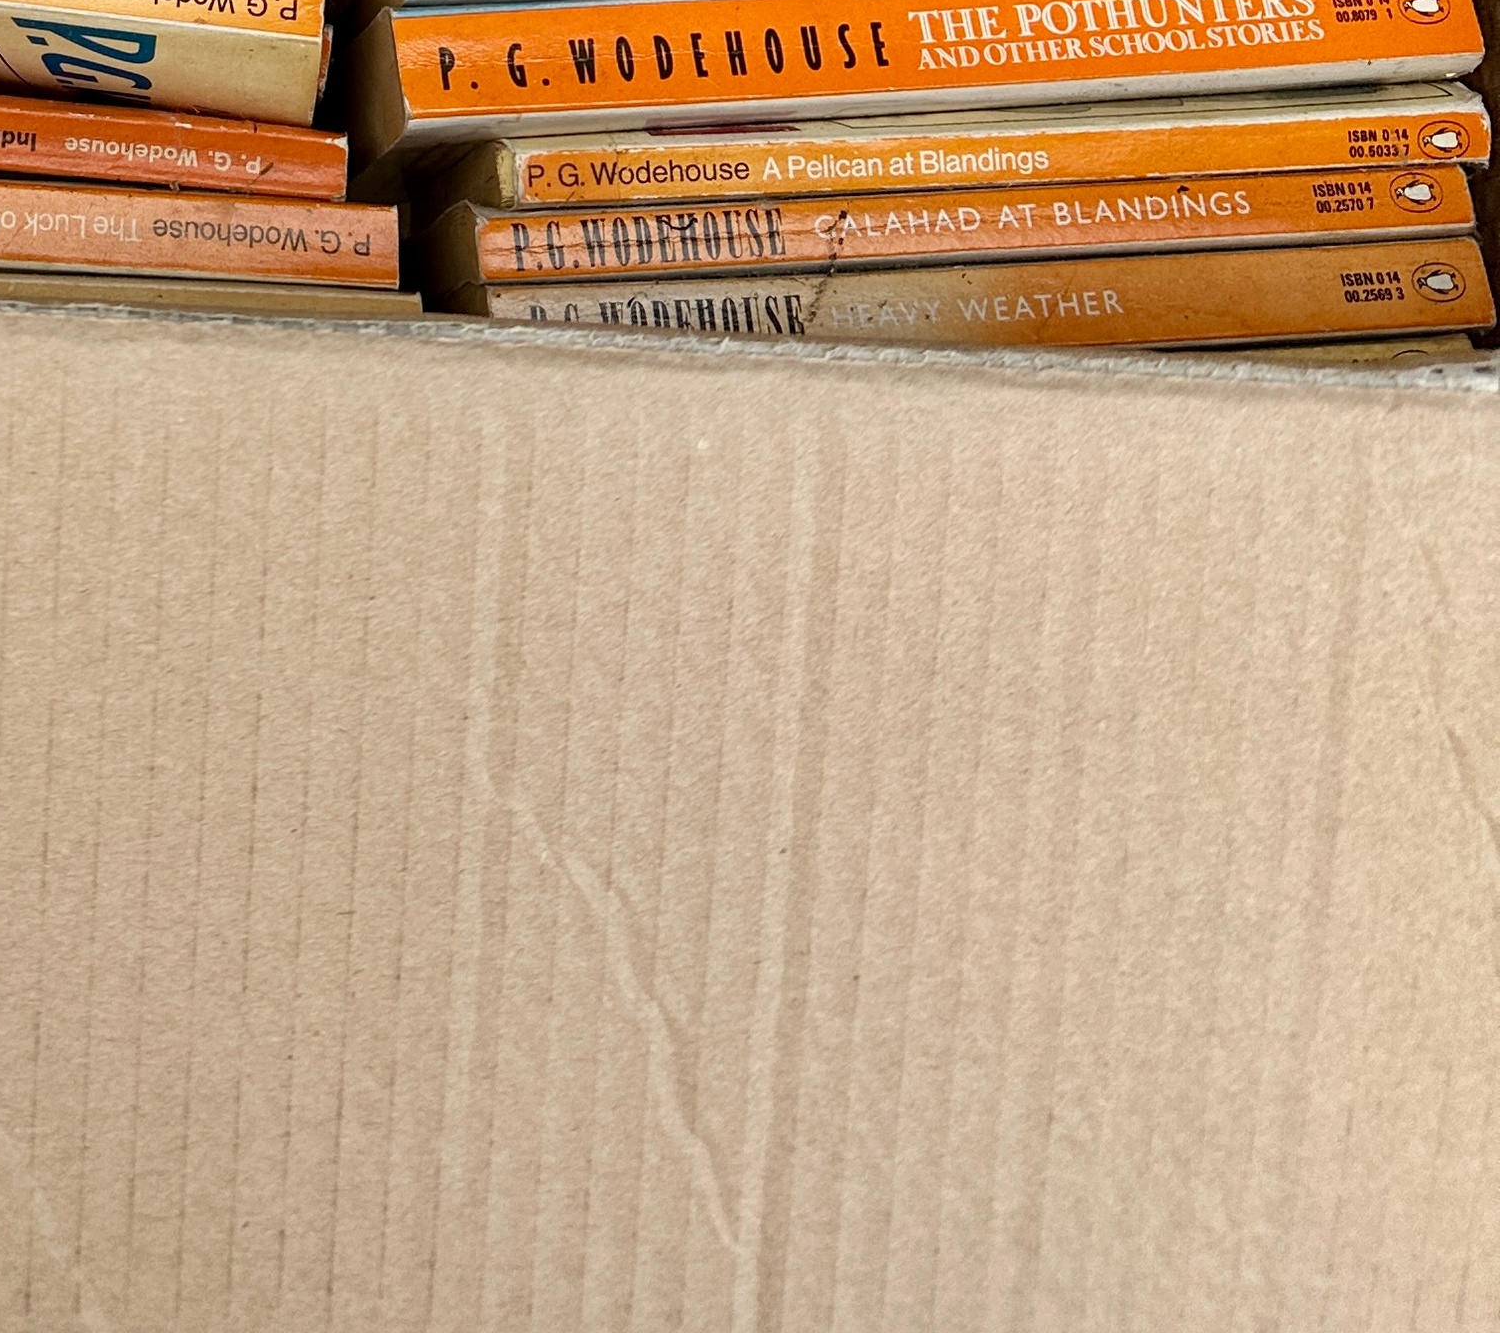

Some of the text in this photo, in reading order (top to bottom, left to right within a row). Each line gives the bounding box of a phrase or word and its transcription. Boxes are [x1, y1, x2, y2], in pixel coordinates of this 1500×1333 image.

[568, 21, 890, 84] WODEHOUSE
[907, 7, 1007, 46] THE
[918, 18, 1325, 71] AND OTHER SCHOOL STORIES
[64, 136, 200, 166] Wodehouse
[591, 145, 1050, 186] Wodehouse Pelican Blandings
[153, 218, 309, 252] Wodehouse
[580, 191, 1251, 267] WODEHOUSE AT BLANDINGS
[958, 290, 1124, 323] WEATHER
